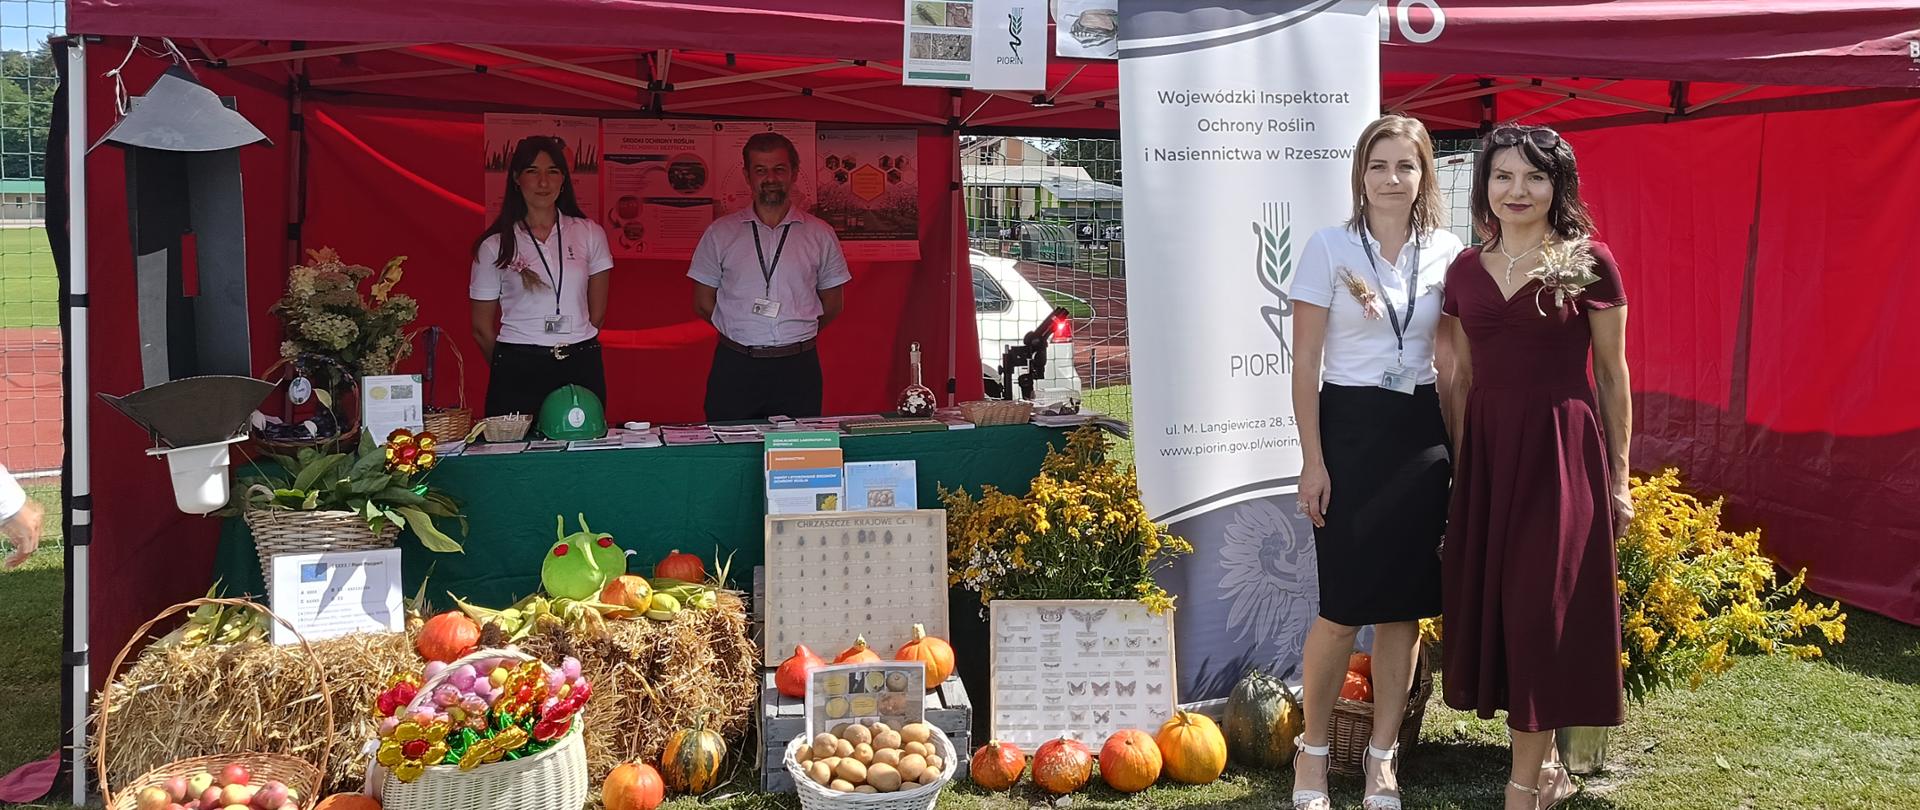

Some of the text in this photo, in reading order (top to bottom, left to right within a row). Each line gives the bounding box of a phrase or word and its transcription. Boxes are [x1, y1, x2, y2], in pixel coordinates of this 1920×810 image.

[996, 56, 1024, 65] PIORIN
[1157, 90, 1350, 106] Wojewódzki Inspektorat
[1197, 118, 1316, 135] Ochrony Roślin
[1144, 145, 1356, 162] i Nasiennictwa w Rzeszowi
[1165, 424, 1180, 435] ul.
[1184, 424, 1197, 433] M.
[1200, 419, 1266, 434] Langiewicza
[1269, 417, 1285, 428] 28,
[797, 519, 850, 529] CHRZĄSZCZE
[854, 517, 892, 526] KRAJOWE
